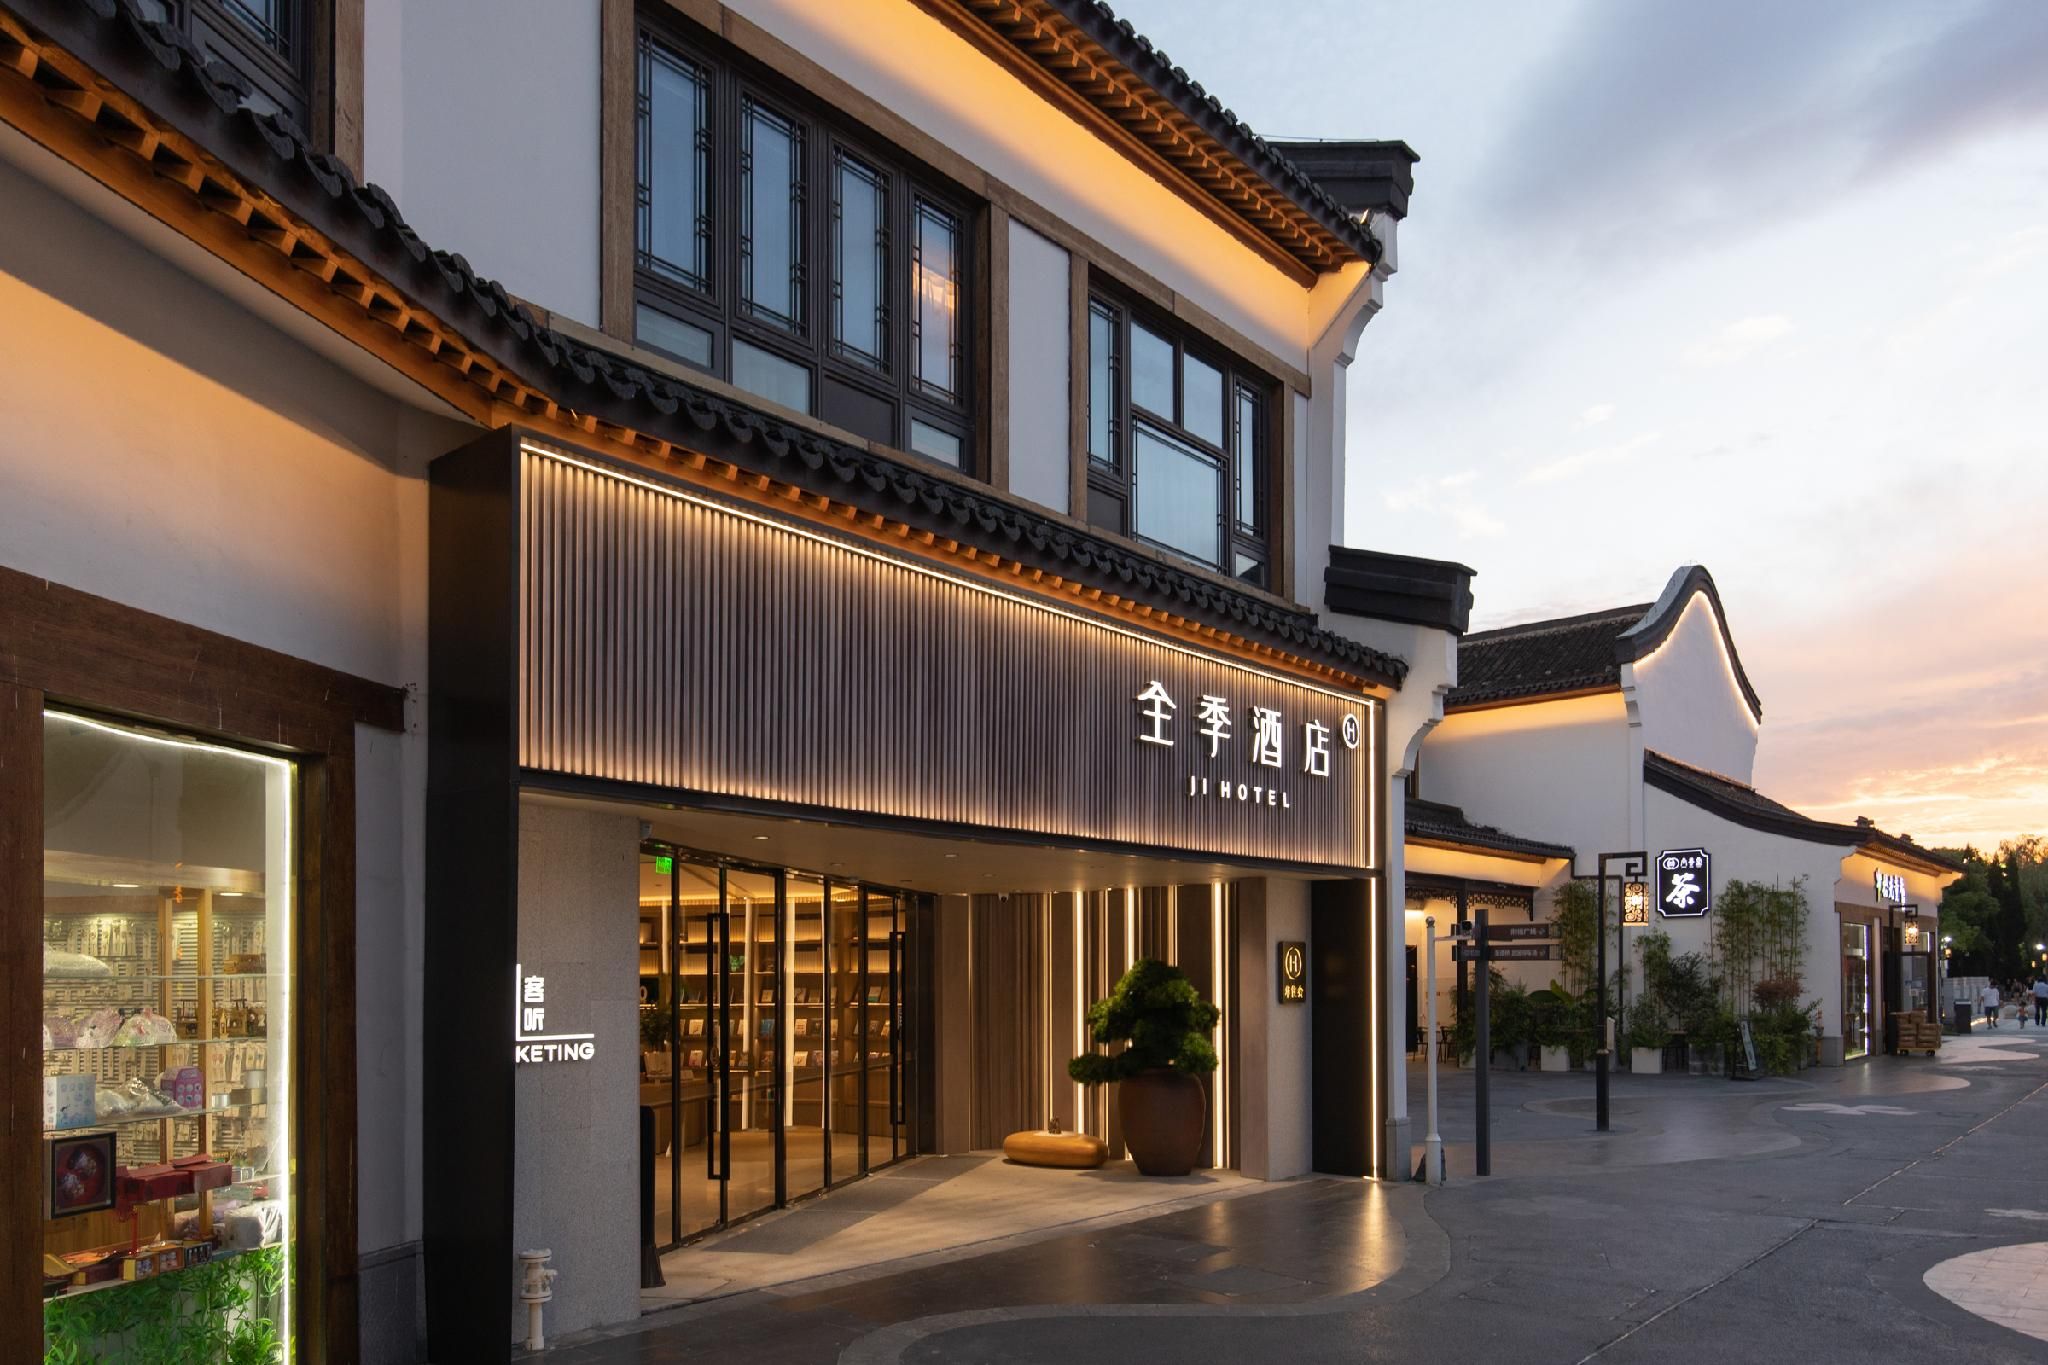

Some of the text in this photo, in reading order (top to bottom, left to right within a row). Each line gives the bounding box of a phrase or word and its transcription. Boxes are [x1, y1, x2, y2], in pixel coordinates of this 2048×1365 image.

[1137, 680, 1330, 777] 全季酒店
[1190, 775, 1291, 809] JI HOTEL
[1665, 872, 1701, 909] 茶
